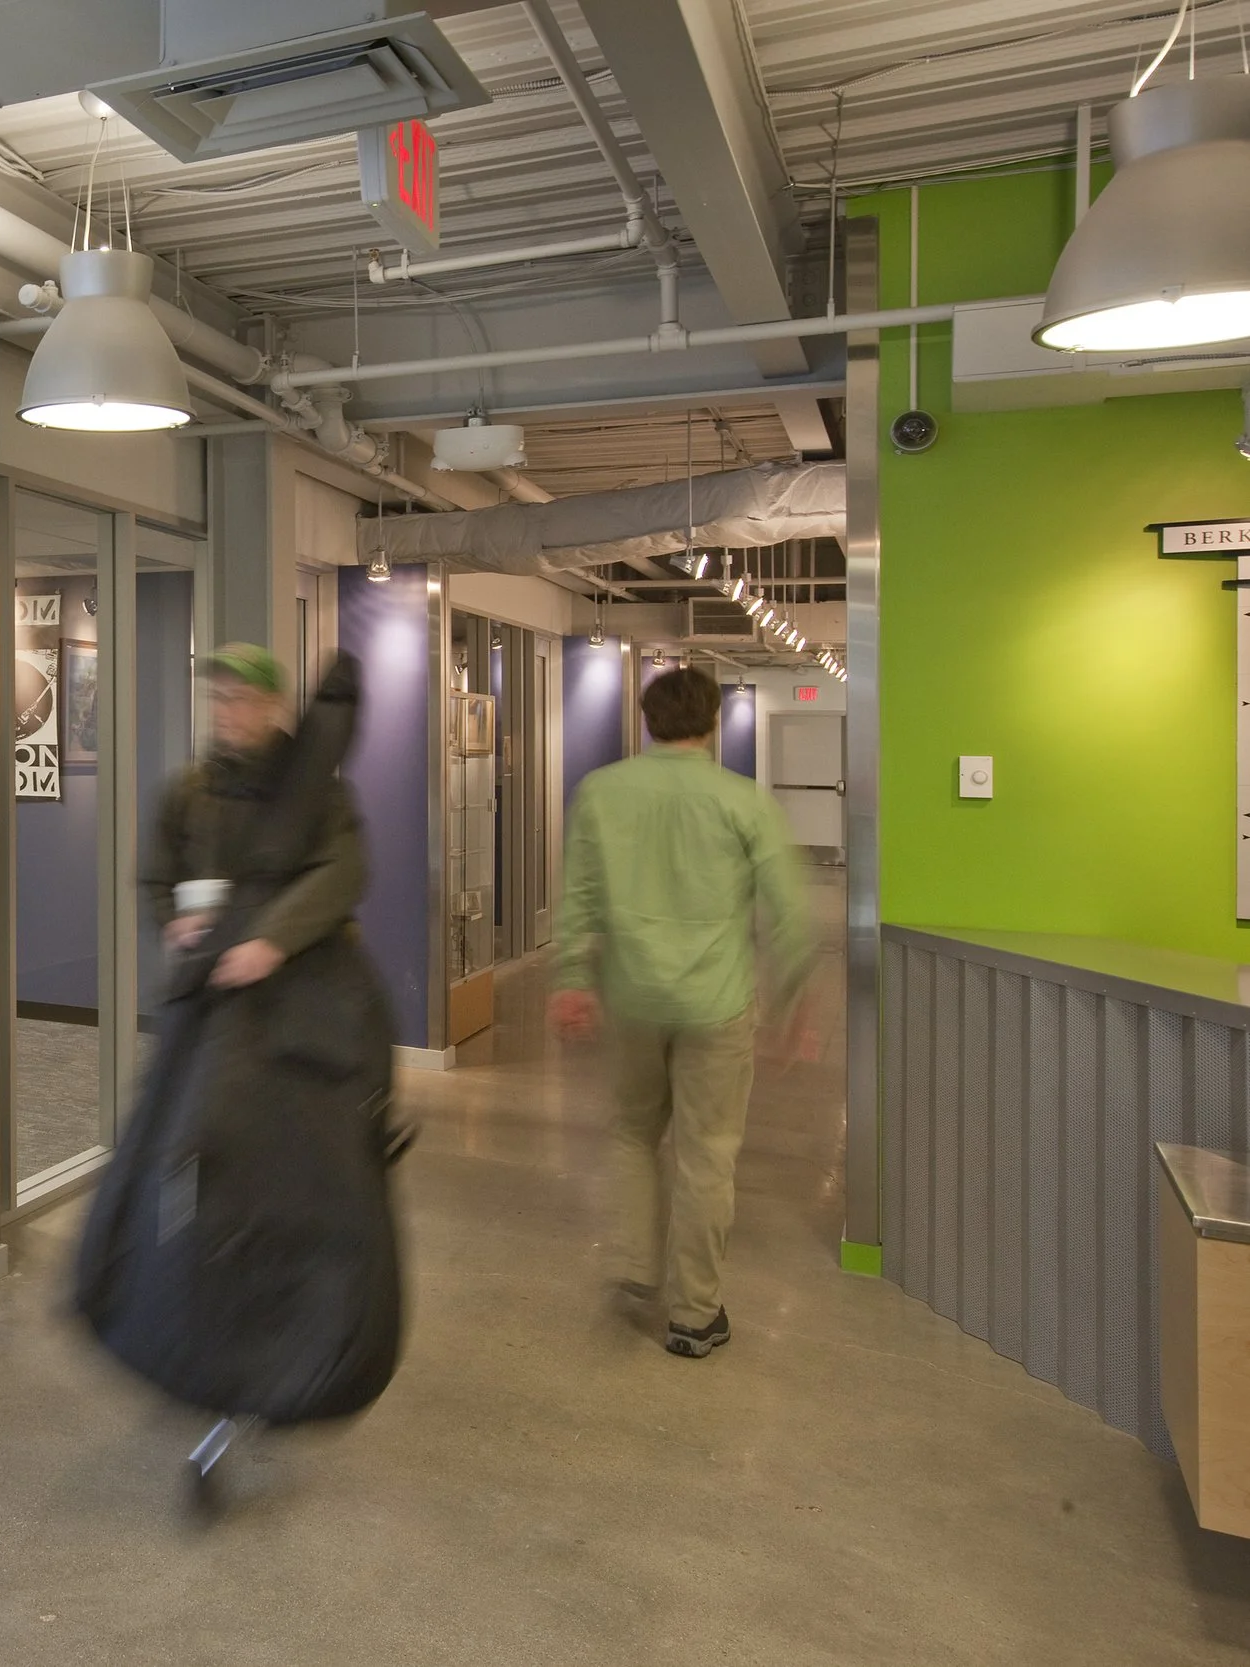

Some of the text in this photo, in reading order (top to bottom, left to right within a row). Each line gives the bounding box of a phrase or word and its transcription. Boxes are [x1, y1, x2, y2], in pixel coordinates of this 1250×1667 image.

[398, 119, 435, 233] EXIT
[1184, 529, 1250, 546] BERK
[799, 687, 818, 702] EXIT
